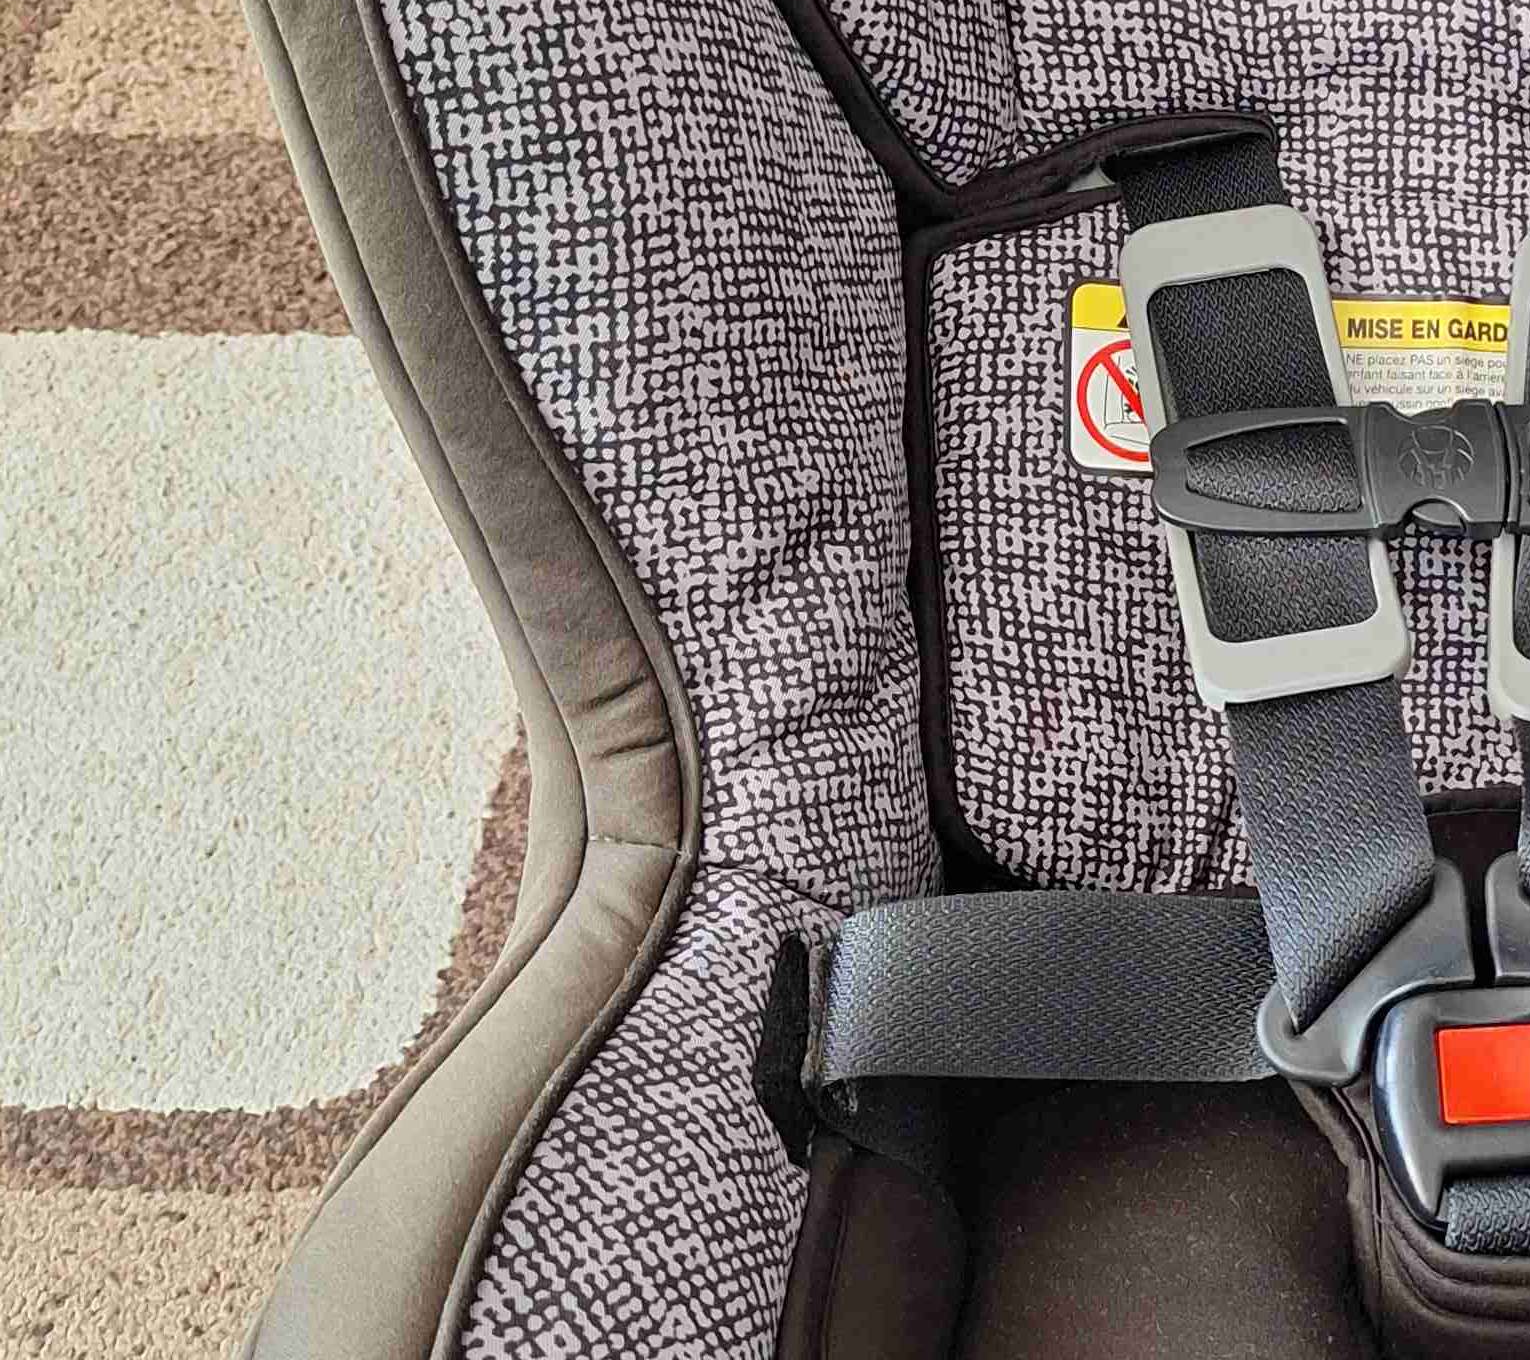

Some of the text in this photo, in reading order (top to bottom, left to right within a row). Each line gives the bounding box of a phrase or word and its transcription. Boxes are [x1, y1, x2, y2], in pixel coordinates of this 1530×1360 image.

[1347, 318, 1508, 342] MISE EN GARD
[1346, 353, 1364, 366] NE
[1367, 353, 1406, 369] placez
[1410, 354, 1434, 366] PAS
[1437, 355, 1452, 366] un
[1416, 385, 1434, 395] sur
[1437, 384, 1452, 395] un
